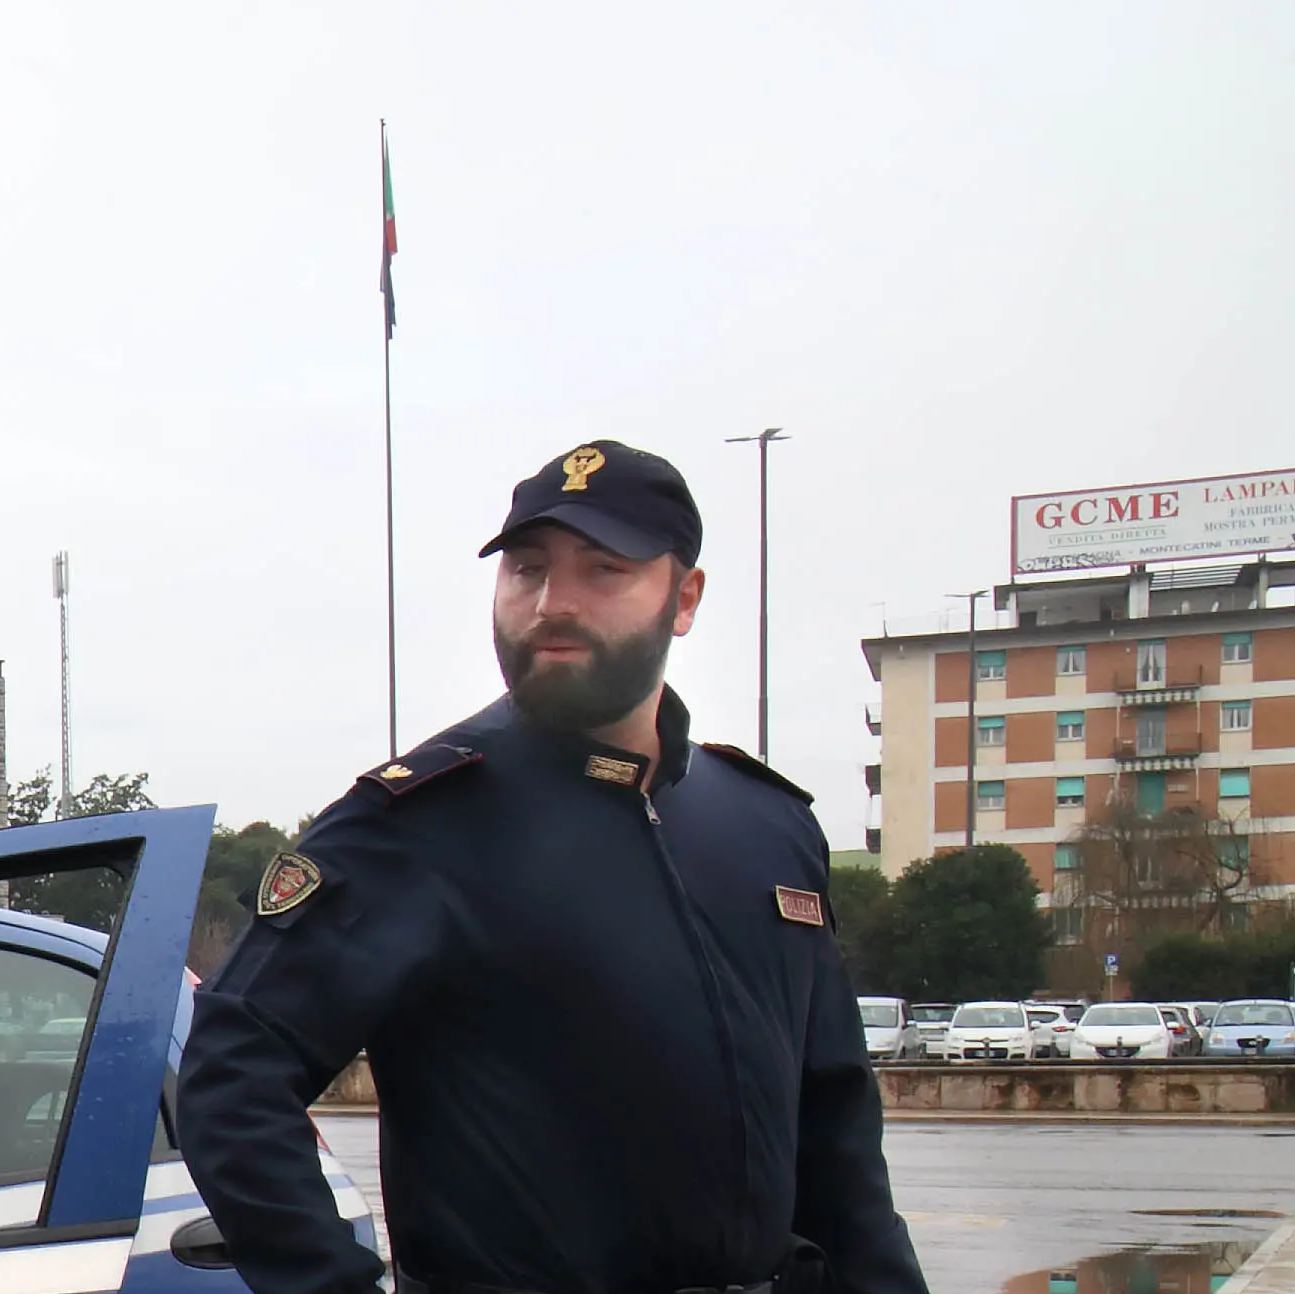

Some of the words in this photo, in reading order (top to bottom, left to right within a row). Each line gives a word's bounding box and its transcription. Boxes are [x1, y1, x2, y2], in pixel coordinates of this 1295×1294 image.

[1204, 479, 1295, 503] LAMPA
[1035, 490, 1180, 530] GCME
[1204, 517, 1257, 533] MOSTRA
[1049, 534, 1104, 546] VENDITA
[1111, 527, 1168, 541] DIRETTA
[1139, 541, 1222, 556] MONTECATINI
[1228, 536, 1271, 548] TERME
